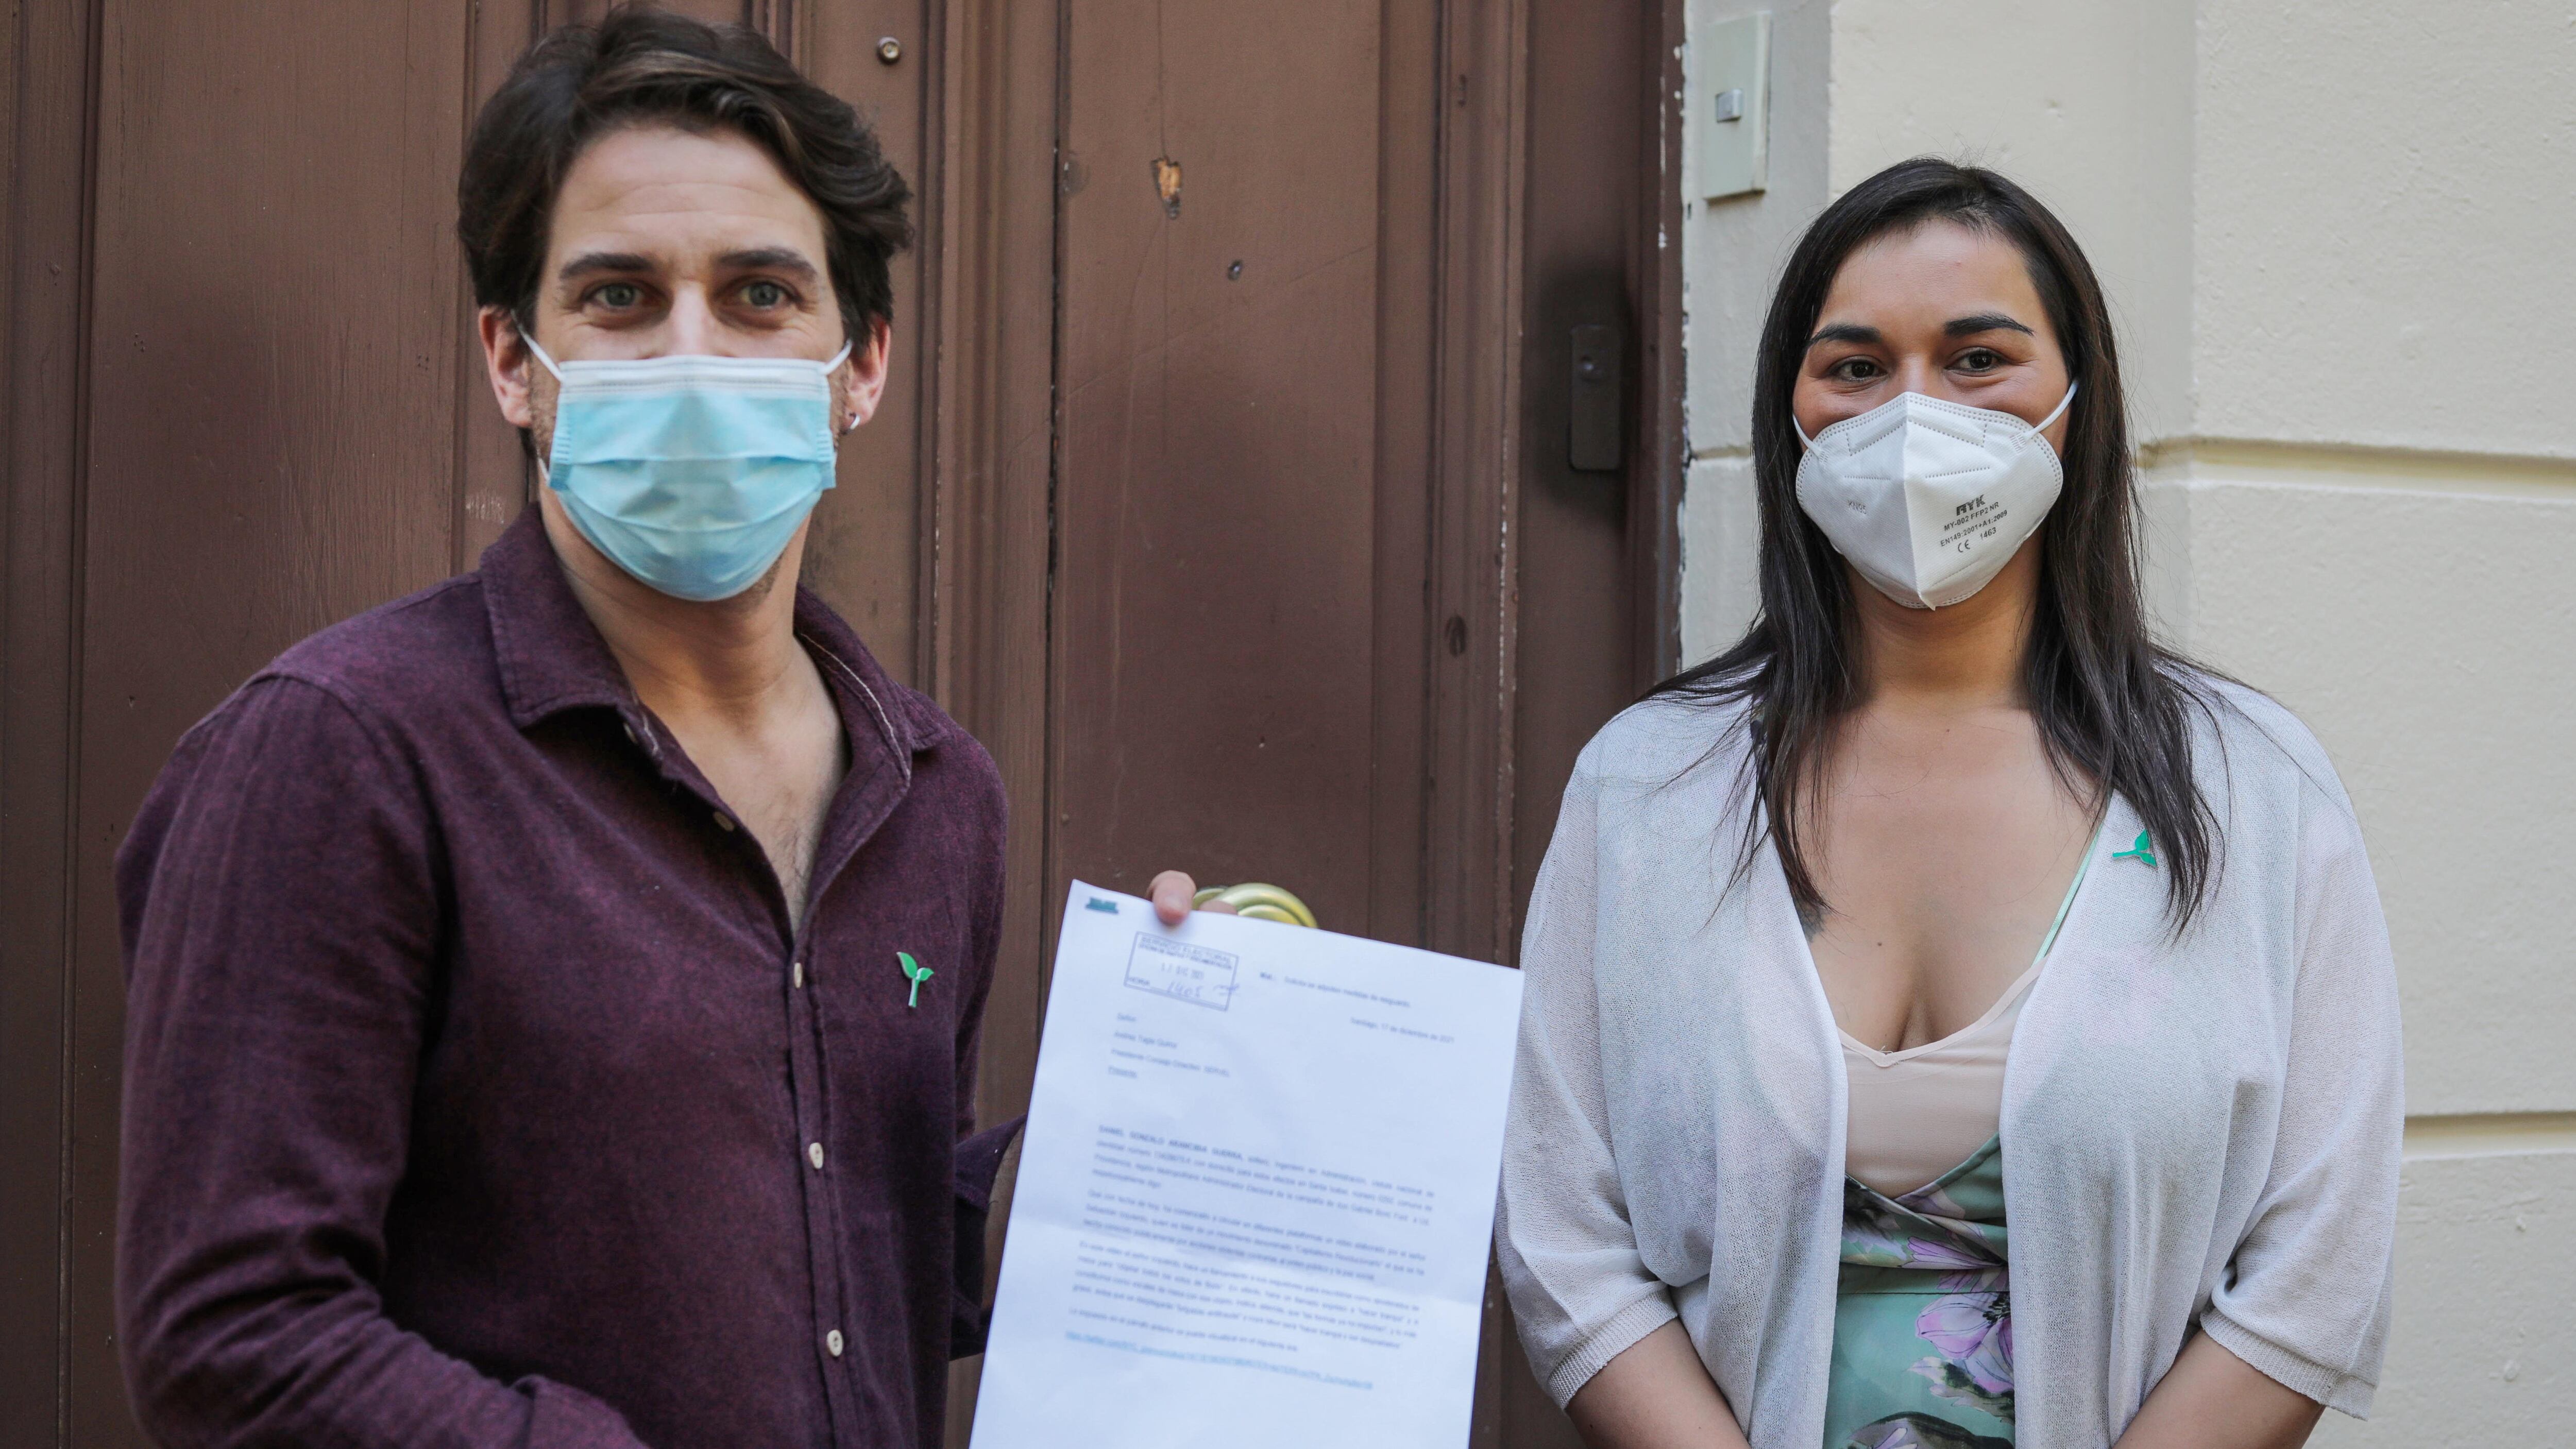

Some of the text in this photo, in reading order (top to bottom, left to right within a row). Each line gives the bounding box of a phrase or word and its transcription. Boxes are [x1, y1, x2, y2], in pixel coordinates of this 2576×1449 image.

[1847, 500, 1867, 515] KN95
[1944, 502, 1999, 531] MY-002 FFP2 NR
[1980, 527, 1996, 540] 1463
